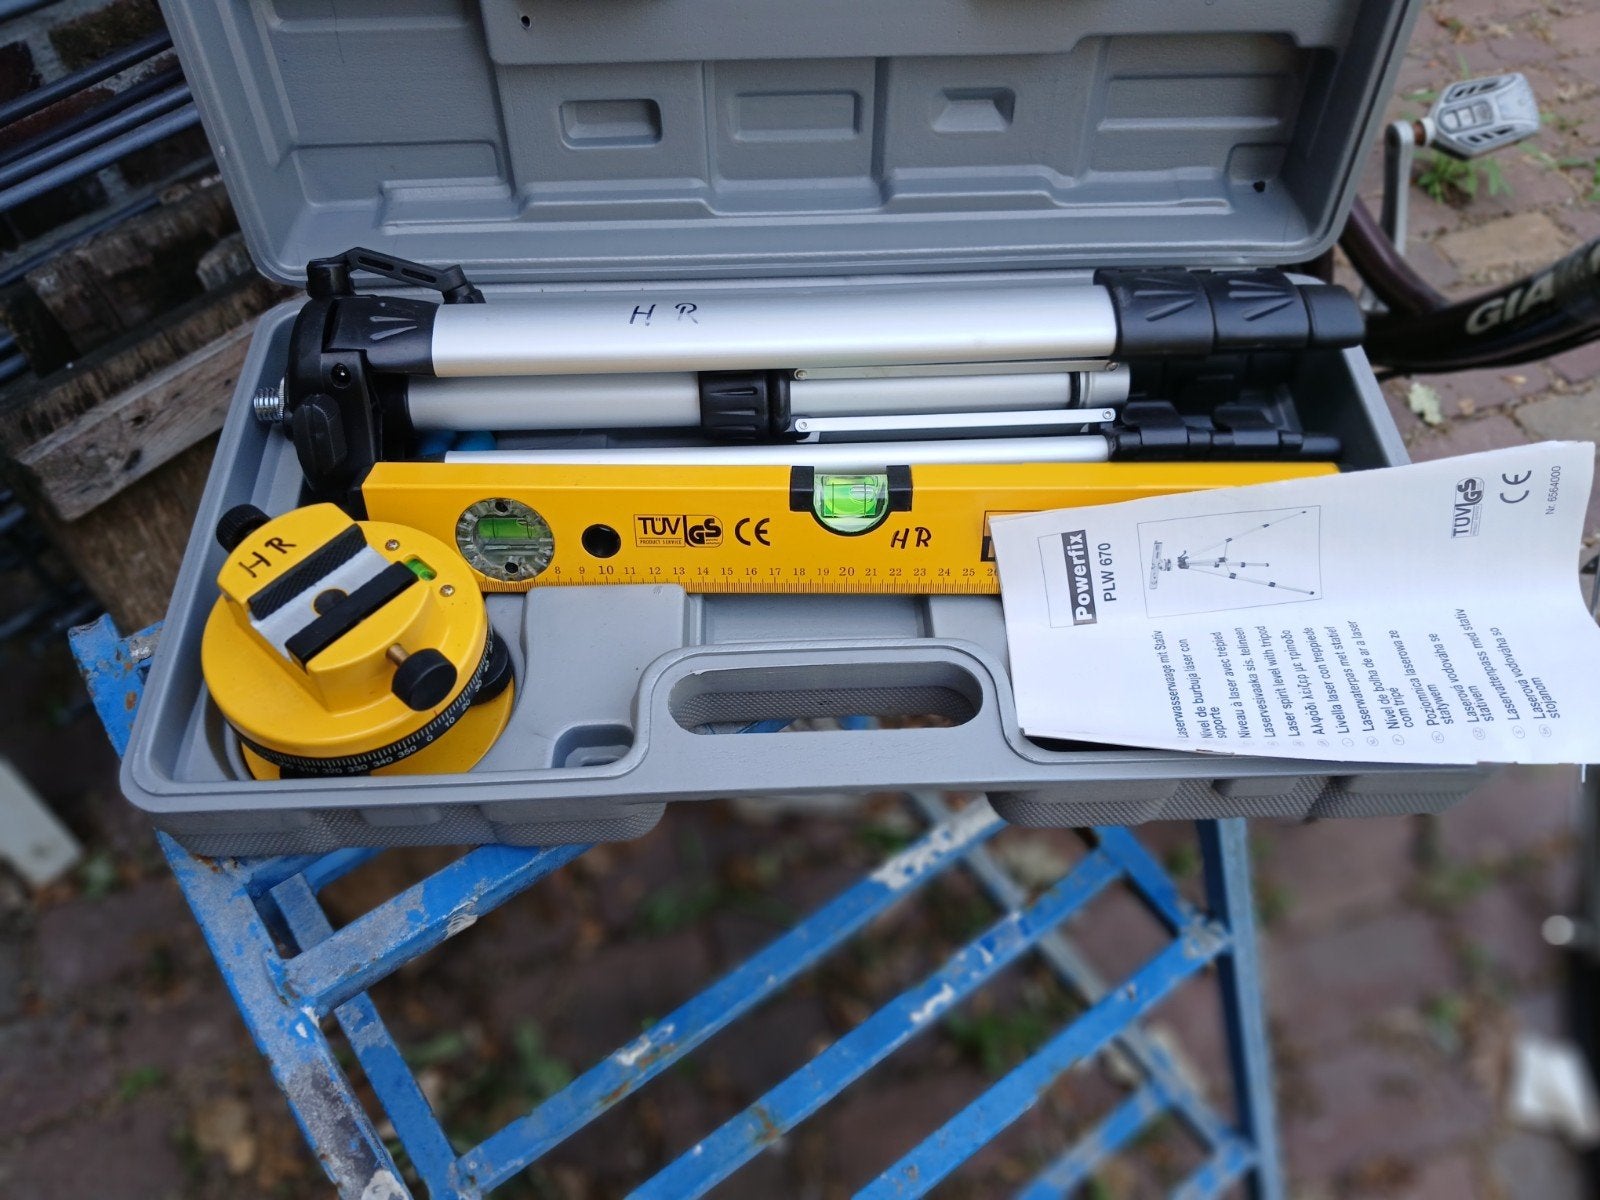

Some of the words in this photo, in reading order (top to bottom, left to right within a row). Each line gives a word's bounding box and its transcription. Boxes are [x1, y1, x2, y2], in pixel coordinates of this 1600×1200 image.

[1457, 478, 1482, 503] GS
[1499, 470, 1532, 504] CE
[637, 517, 681, 536] TÜV
[688, 517, 722, 545] GS
[734, 517, 770, 546] CE
[1098, 543, 1113, 566] 670
[554, 567, 561, 575] 8
[578, 567, 586, 575] 9
[598, 565, 614, 575] 10
[624, 567, 636, 575] 11
[649, 567, 661, 575] 12
[673, 567, 685, 575] 13
[697, 567, 710, 575] 14
[721, 567, 733, 575] 15
[745, 567, 758, 575] 16
[769, 567, 781, 575] 17
[793, 568, 806, 576] 18
[817, 568, 830, 576] 19
[839, 565, 855, 576] 20
[865, 568, 878, 576] 21
[889, 568, 902, 576] 22
[913, 568, 927, 576] 23
[937, 568, 951, 576] 24
[962, 568, 975, 576] 25
[1066, 532, 1093, 621] Powerfix
[1100, 570, 1116, 602] PLW
[1347, 620, 1363, 639] laser
[1454, 608, 1473, 631] stativ
[1152, 630, 1166, 651] Stativ
[1235, 627, 1251, 656] telineen
[1254, 625, 1271, 648] tripod
[1323, 626, 1343, 651] statief
[1388, 629, 1400, 639] ze
[1429, 632, 1440, 642] se
[1464, 631, 1484, 649] med
[1489, 626, 1502, 637] so
[1179, 639, 1190, 652] con
[1302, 627, 1325, 662] treppiede
[1358, 647, 1370, 656] ar
[1157, 651, 1170, 663] mit
[1221, 658, 1234, 677] avec
[1262, 649, 1277, 667] with
[1293, 662, 1307, 672] με
[1334, 652, 1350, 667] met
[1363, 657, 1375, 668] de
[1393, 640, 1416, 676] laserowa
[1433, 643, 1459, 683] vodováha
[1496, 636, 1523, 678] vodováha
[1268, 667, 1284, 687] level
[1318, 664, 1331, 679] con
[1367, 670, 1385, 692] bolha
[1187, 673, 1204, 704] burbuja
[1227, 678, 1240, 700] laser
[1324, 681, 1339, 702] laser
[1386, 687, 1405, 706] tripé
[1477, 650, 1520, 721] Laservattenpass
[1163, 664, 1189, 738] Laserwasserwaage
[1248, 673, 1276, 737] Laservesivaaka
[1275, 686, 1293, 709] spirit
[1343, 668, 1375, 731] Laserwaterpas
[1377, 693, 1390, 705] de
[1410, 677, 1440, 726] Poziomnica
[1427, 684, 1454, 725] statywem
[1449, 684, 1480, 723] Laserová
[1468, 685, 1494, 722] stativem
[1514, 678, 1546, 719] Laserová
[1531, 676, 1560, 719] stojanom
[1195, 706, 1207, 718] de
[1209, 706, 1227, 739] soporte
[1236, 709, 1251, 738] Niveau
[1284, 711, 1300, 736] Laser
[1330, 704, 1350, 734] Livella
[1398, 707, 1414, 728] com
[349, 764, 368, 773] 330
[372, 756, 394, 768] 340
[397, 745, 417, 758] 350
[426, 734, 433, 742] 0
[444, 716, 455, 728] 10
[461, 699, 471, 711] 20
[474, 679, 483, 692] 30
[1197, 719, 1213, 739] Nivel
